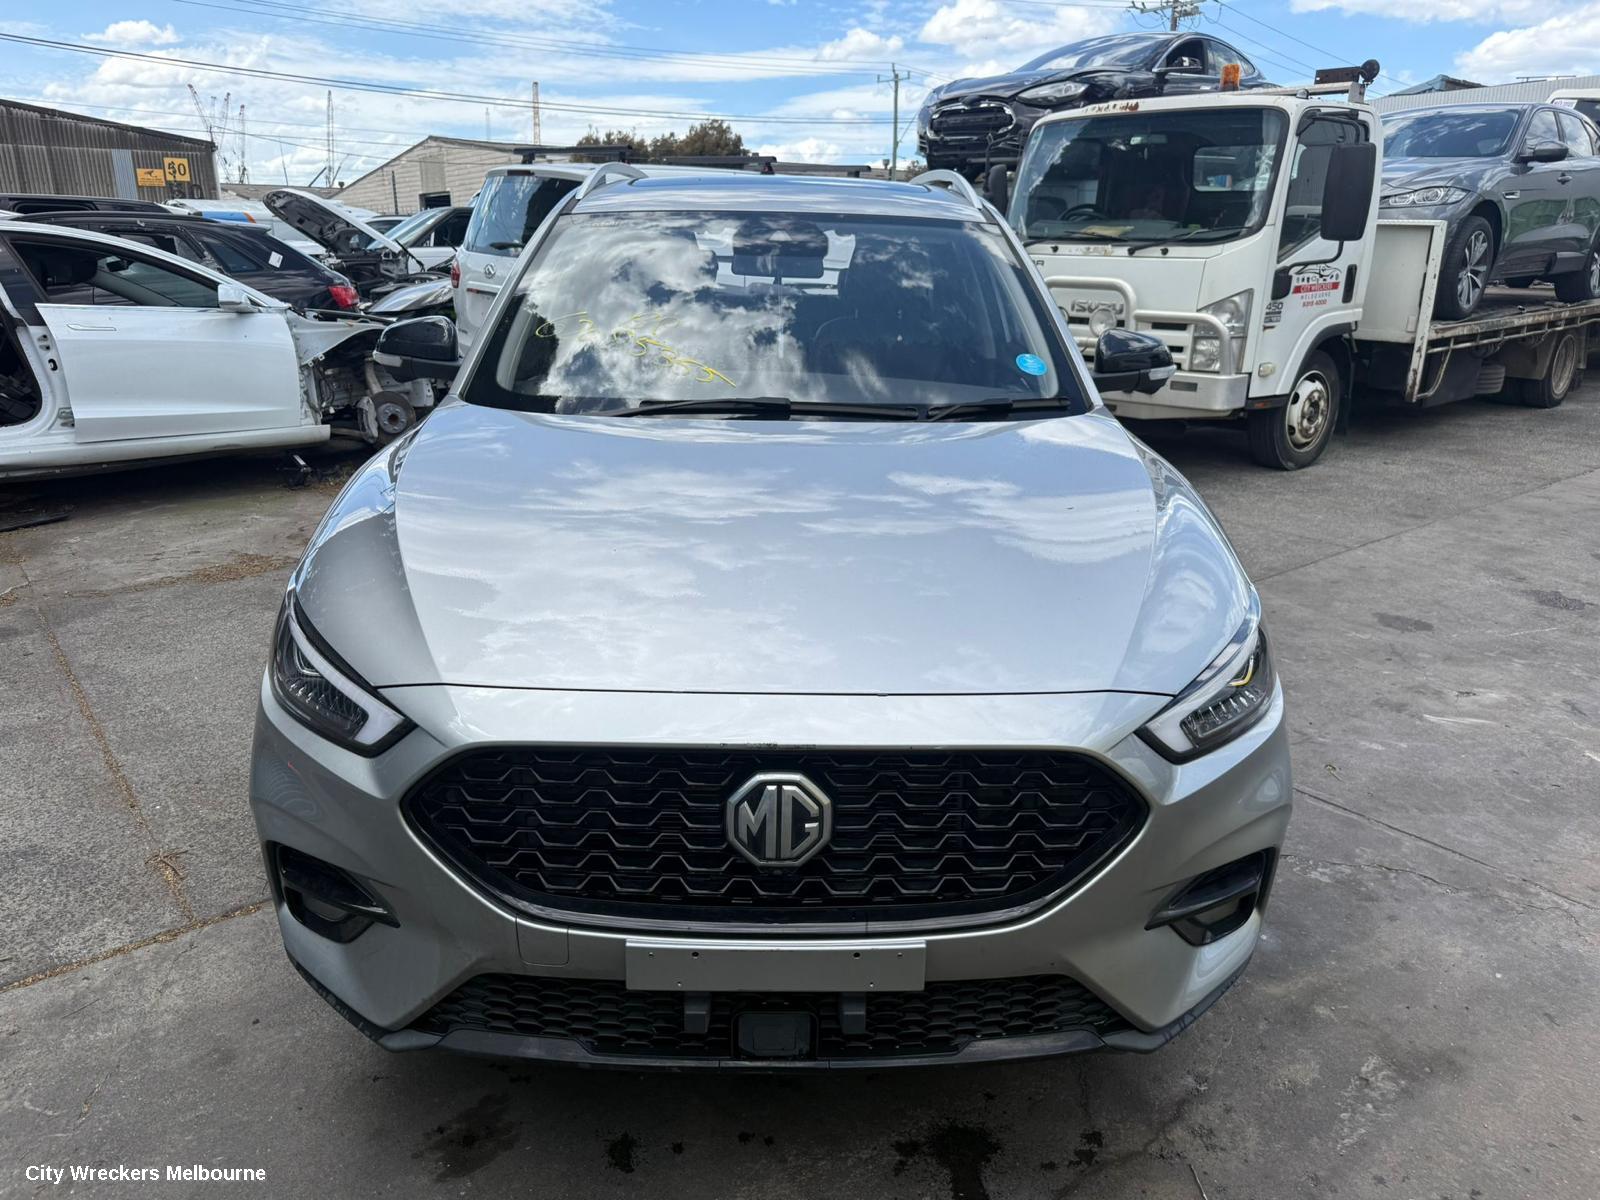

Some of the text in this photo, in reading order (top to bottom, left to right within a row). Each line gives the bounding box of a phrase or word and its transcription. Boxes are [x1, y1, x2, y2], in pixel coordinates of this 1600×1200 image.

[1300, 292, 1332, 300] MELBOURNE
[1265, 301, 1283, 310] 450
[738, 785, 819, 859] MG
